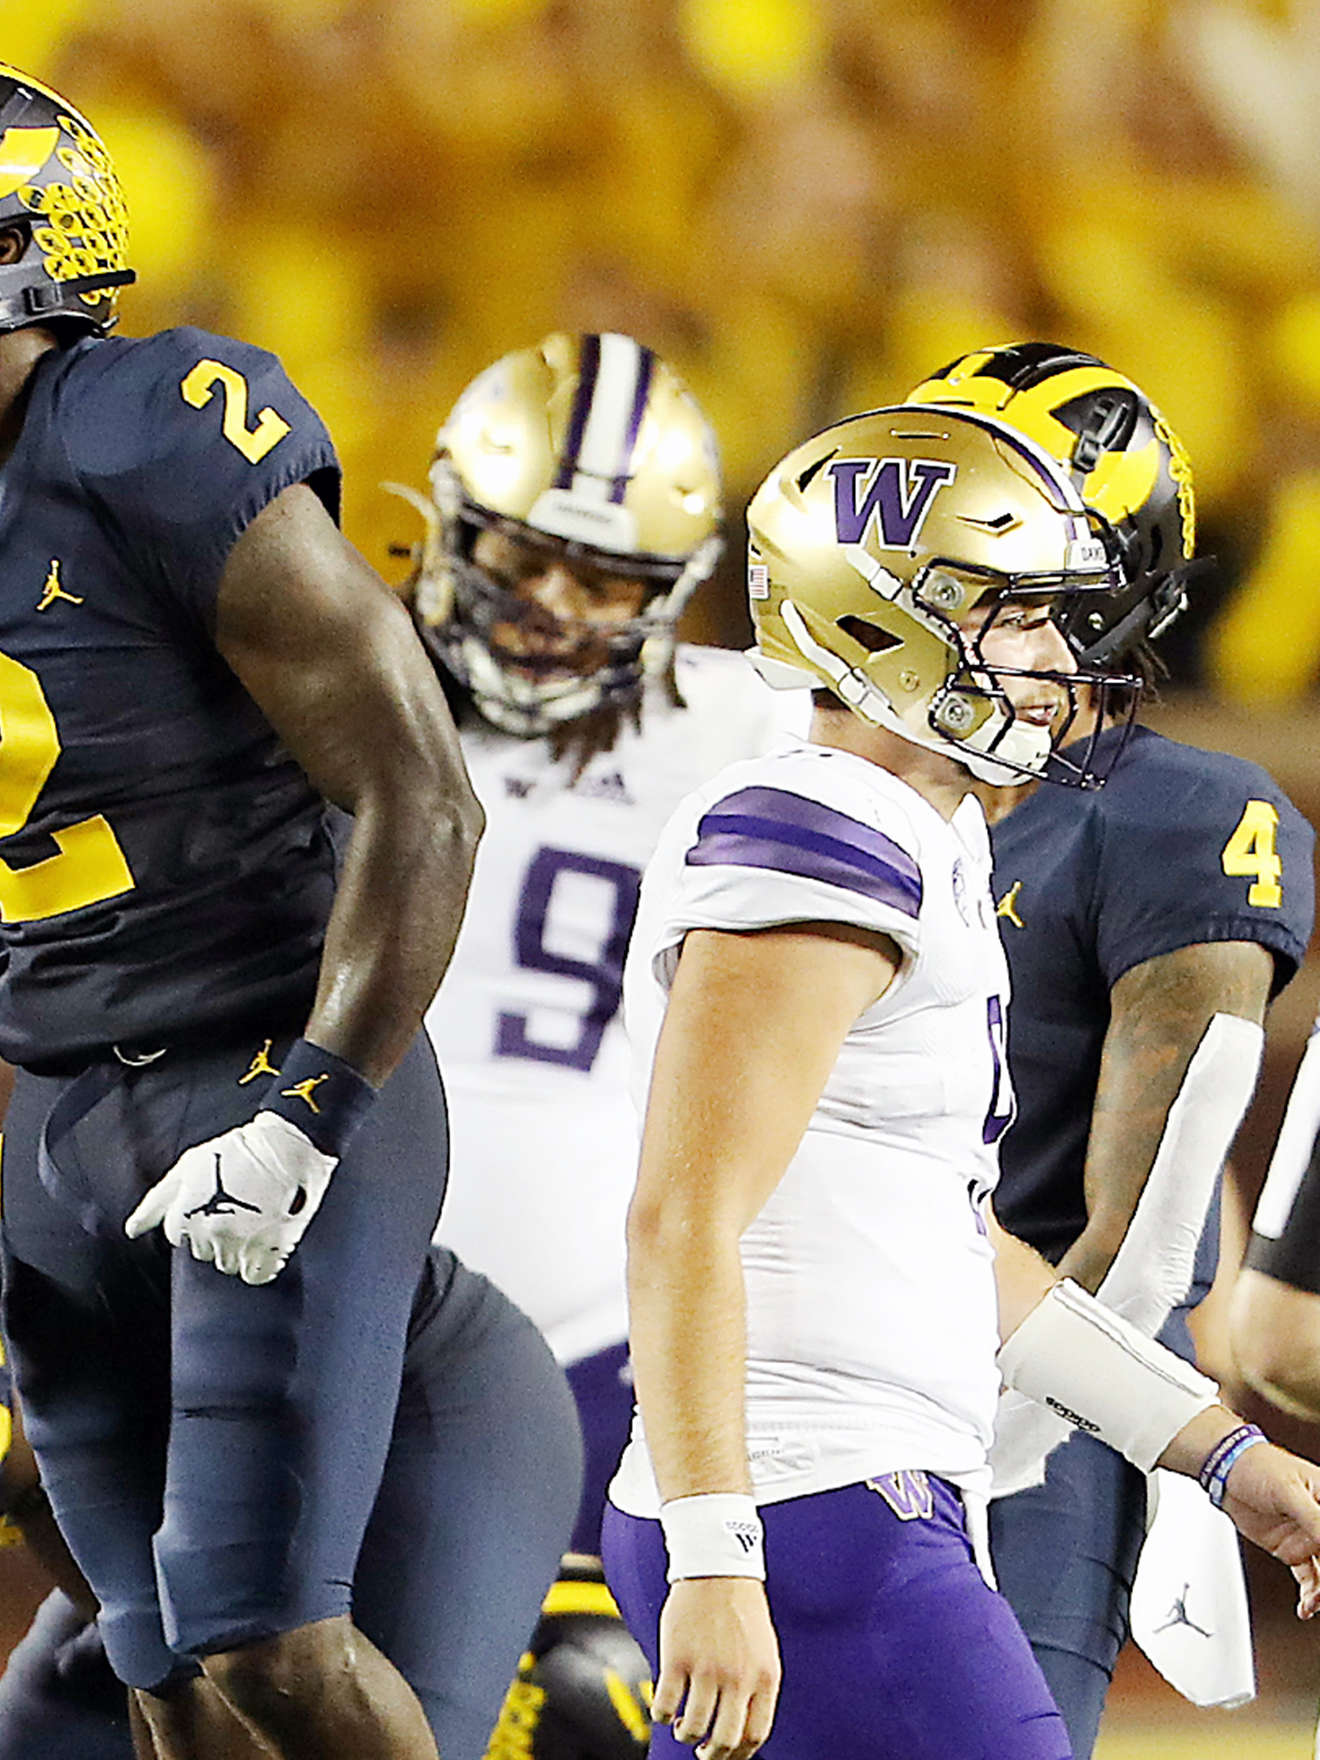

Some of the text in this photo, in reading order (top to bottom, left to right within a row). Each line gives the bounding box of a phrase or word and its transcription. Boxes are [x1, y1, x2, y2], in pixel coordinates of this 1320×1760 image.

[180, 358, 292, 465] 2
[823, 457, 958, 552] W
[1221, 798, 1283, 909] 4
[865, 1469, 934, 1521] W
